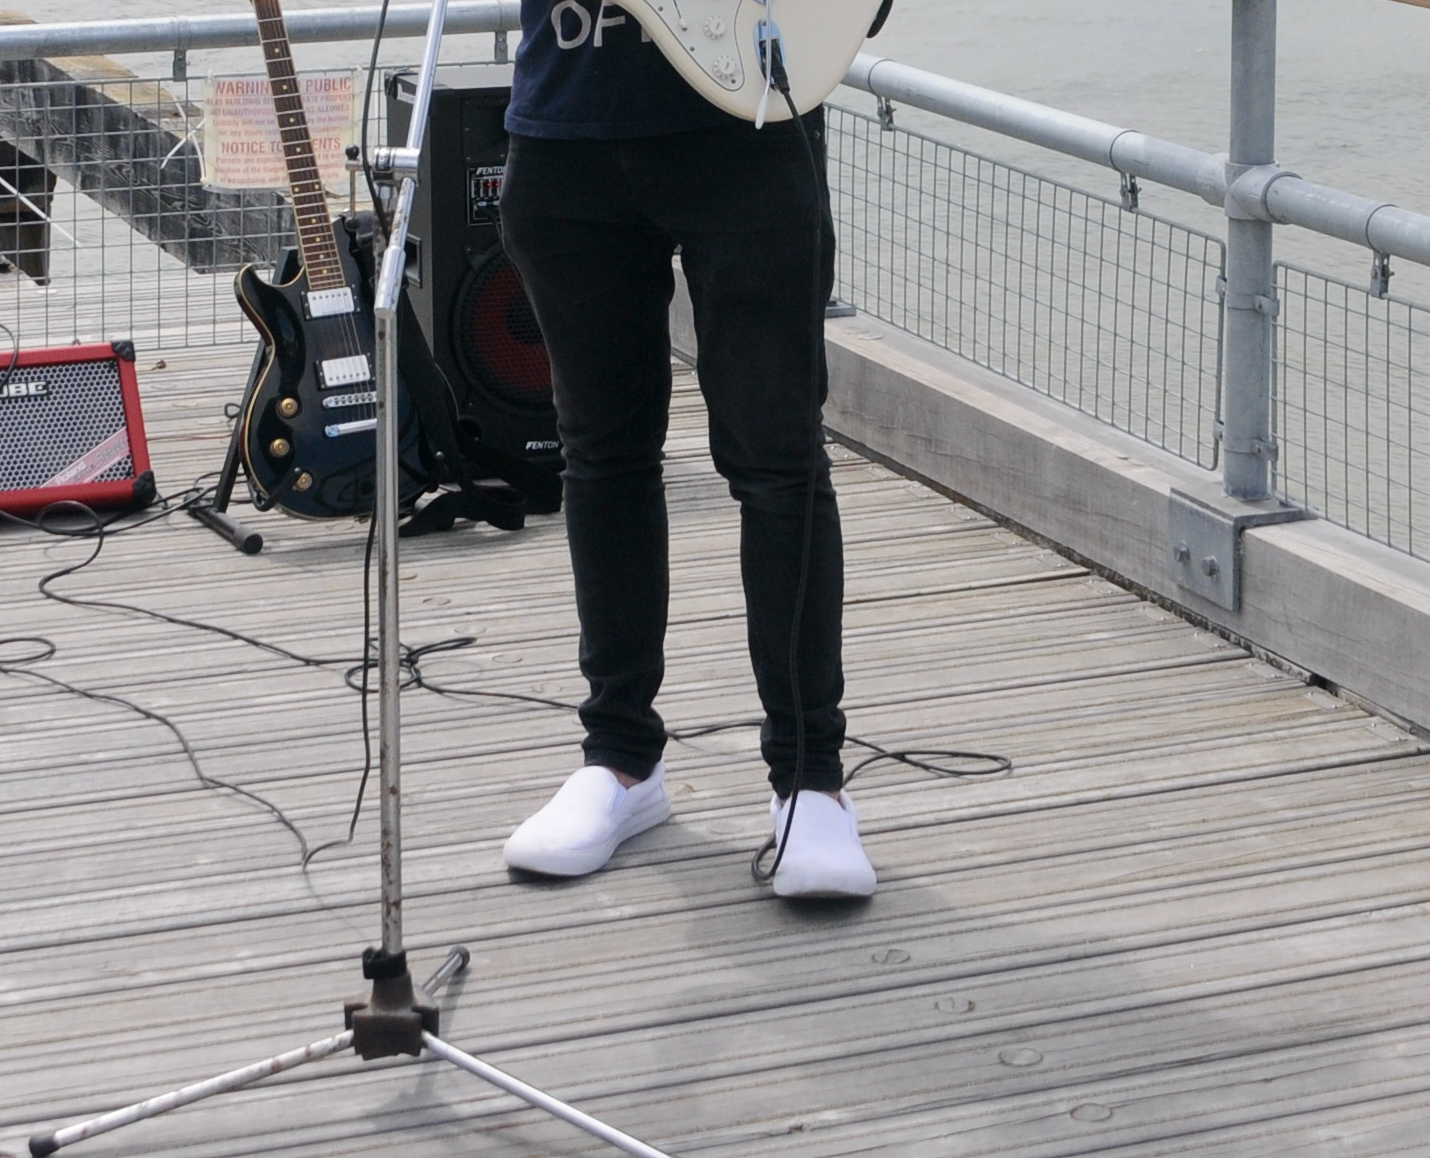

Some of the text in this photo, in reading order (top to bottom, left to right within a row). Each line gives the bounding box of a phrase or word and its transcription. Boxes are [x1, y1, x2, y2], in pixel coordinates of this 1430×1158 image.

[216, 77, 351, 94] WARNIN PUBLIC
[222, 141, 265, 154] NOTICE
[313, 137, 341, 150] ENTS
[476, 166, 506, 175] FENTO
